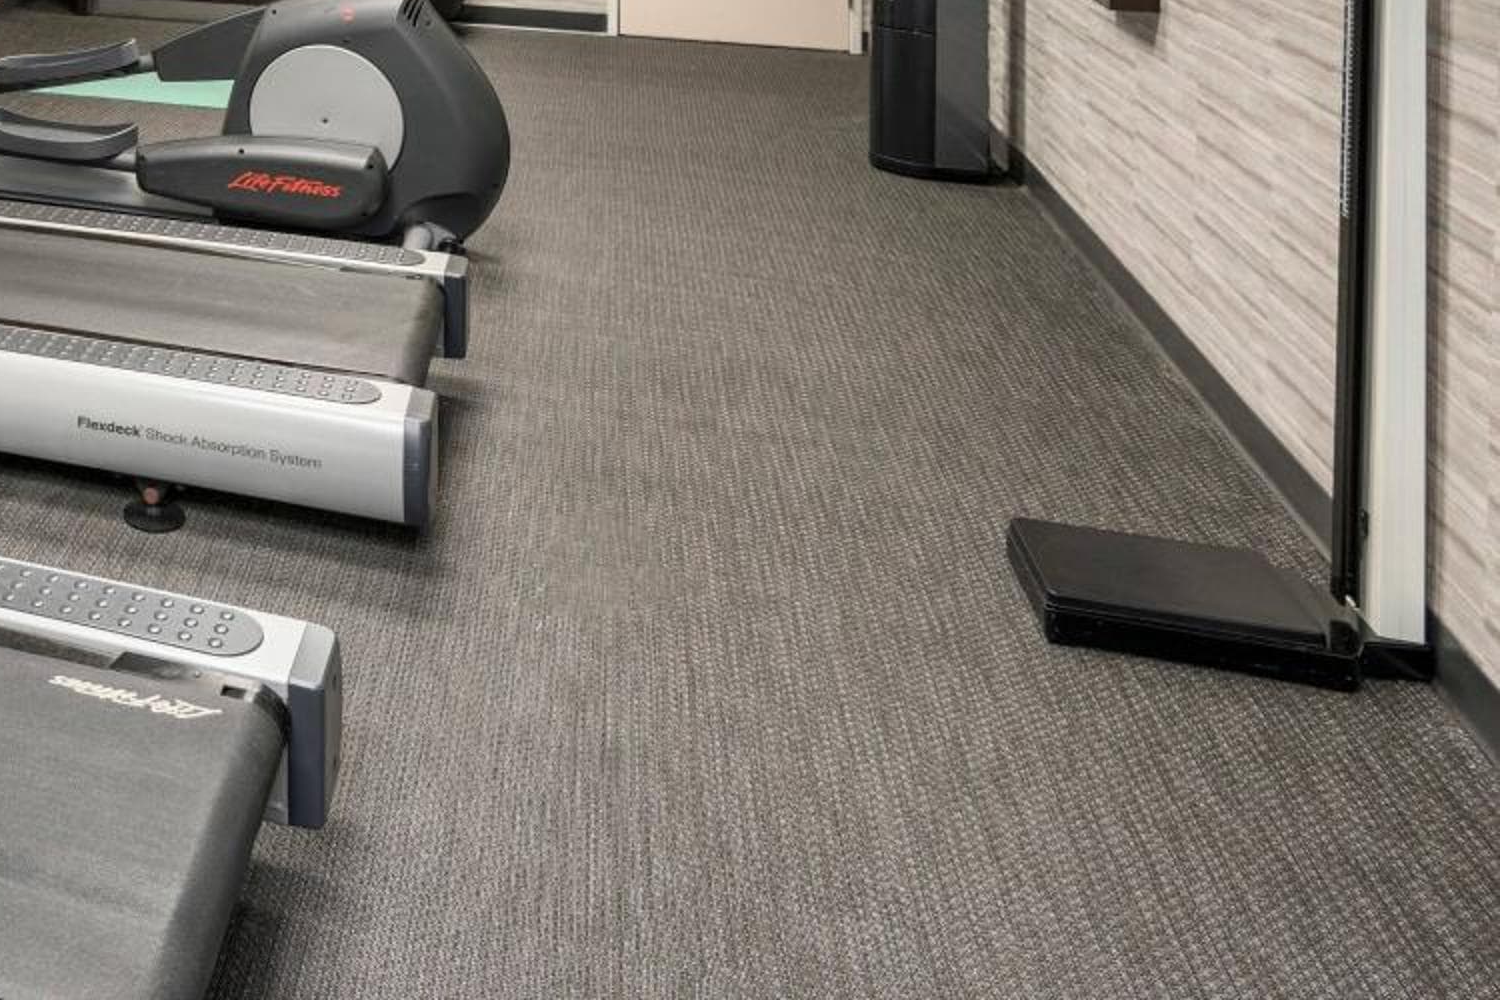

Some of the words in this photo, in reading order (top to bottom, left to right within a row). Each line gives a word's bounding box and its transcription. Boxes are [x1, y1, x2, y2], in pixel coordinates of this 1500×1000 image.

[228, 171, 271, 192] Life
[266, 176, 342, 197] Fitness
[77, 415, 140, 438] Flexdeck
[145, 427, 187, 446] Shock
[190, 435, 267, 460] Absorption
[270, 448, 323, 470] System
